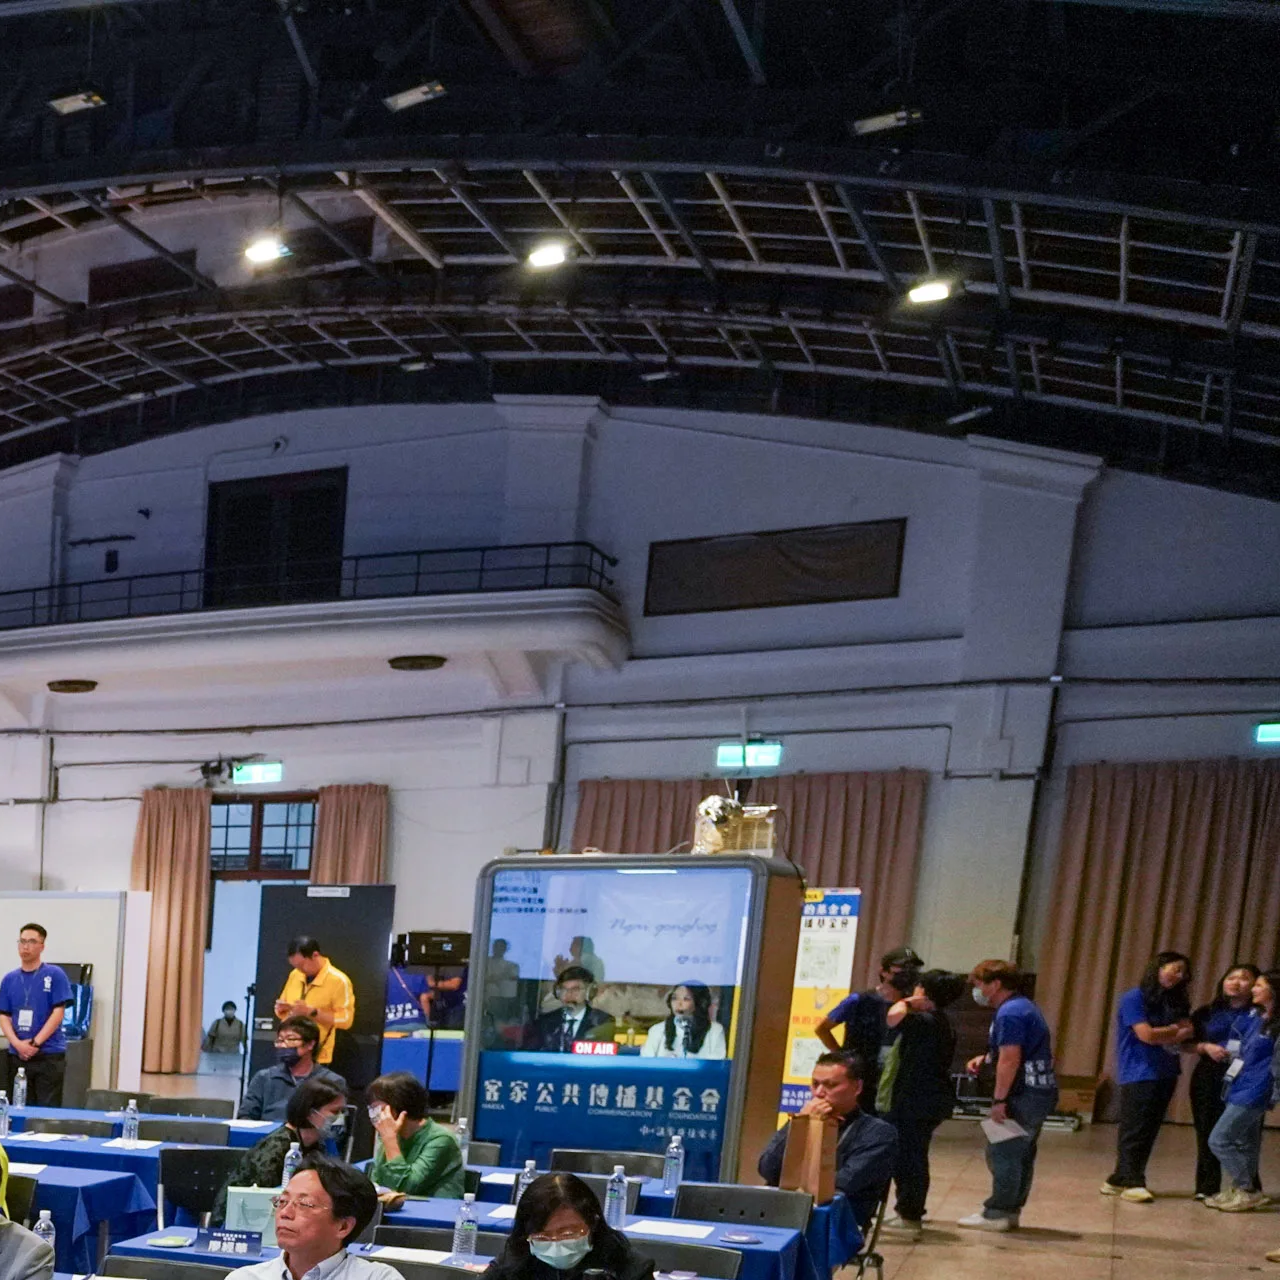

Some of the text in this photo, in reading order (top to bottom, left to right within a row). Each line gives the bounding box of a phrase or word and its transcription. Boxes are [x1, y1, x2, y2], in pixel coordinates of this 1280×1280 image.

[575, 1042, 615, 1055] ON AIR
[483, 1078, 721, 1113] 客家公共傳播基金會
[588, 1108, 653, 1118] COMMUNICATION
[669, 1112, 718, 1121] FOUNDATION
